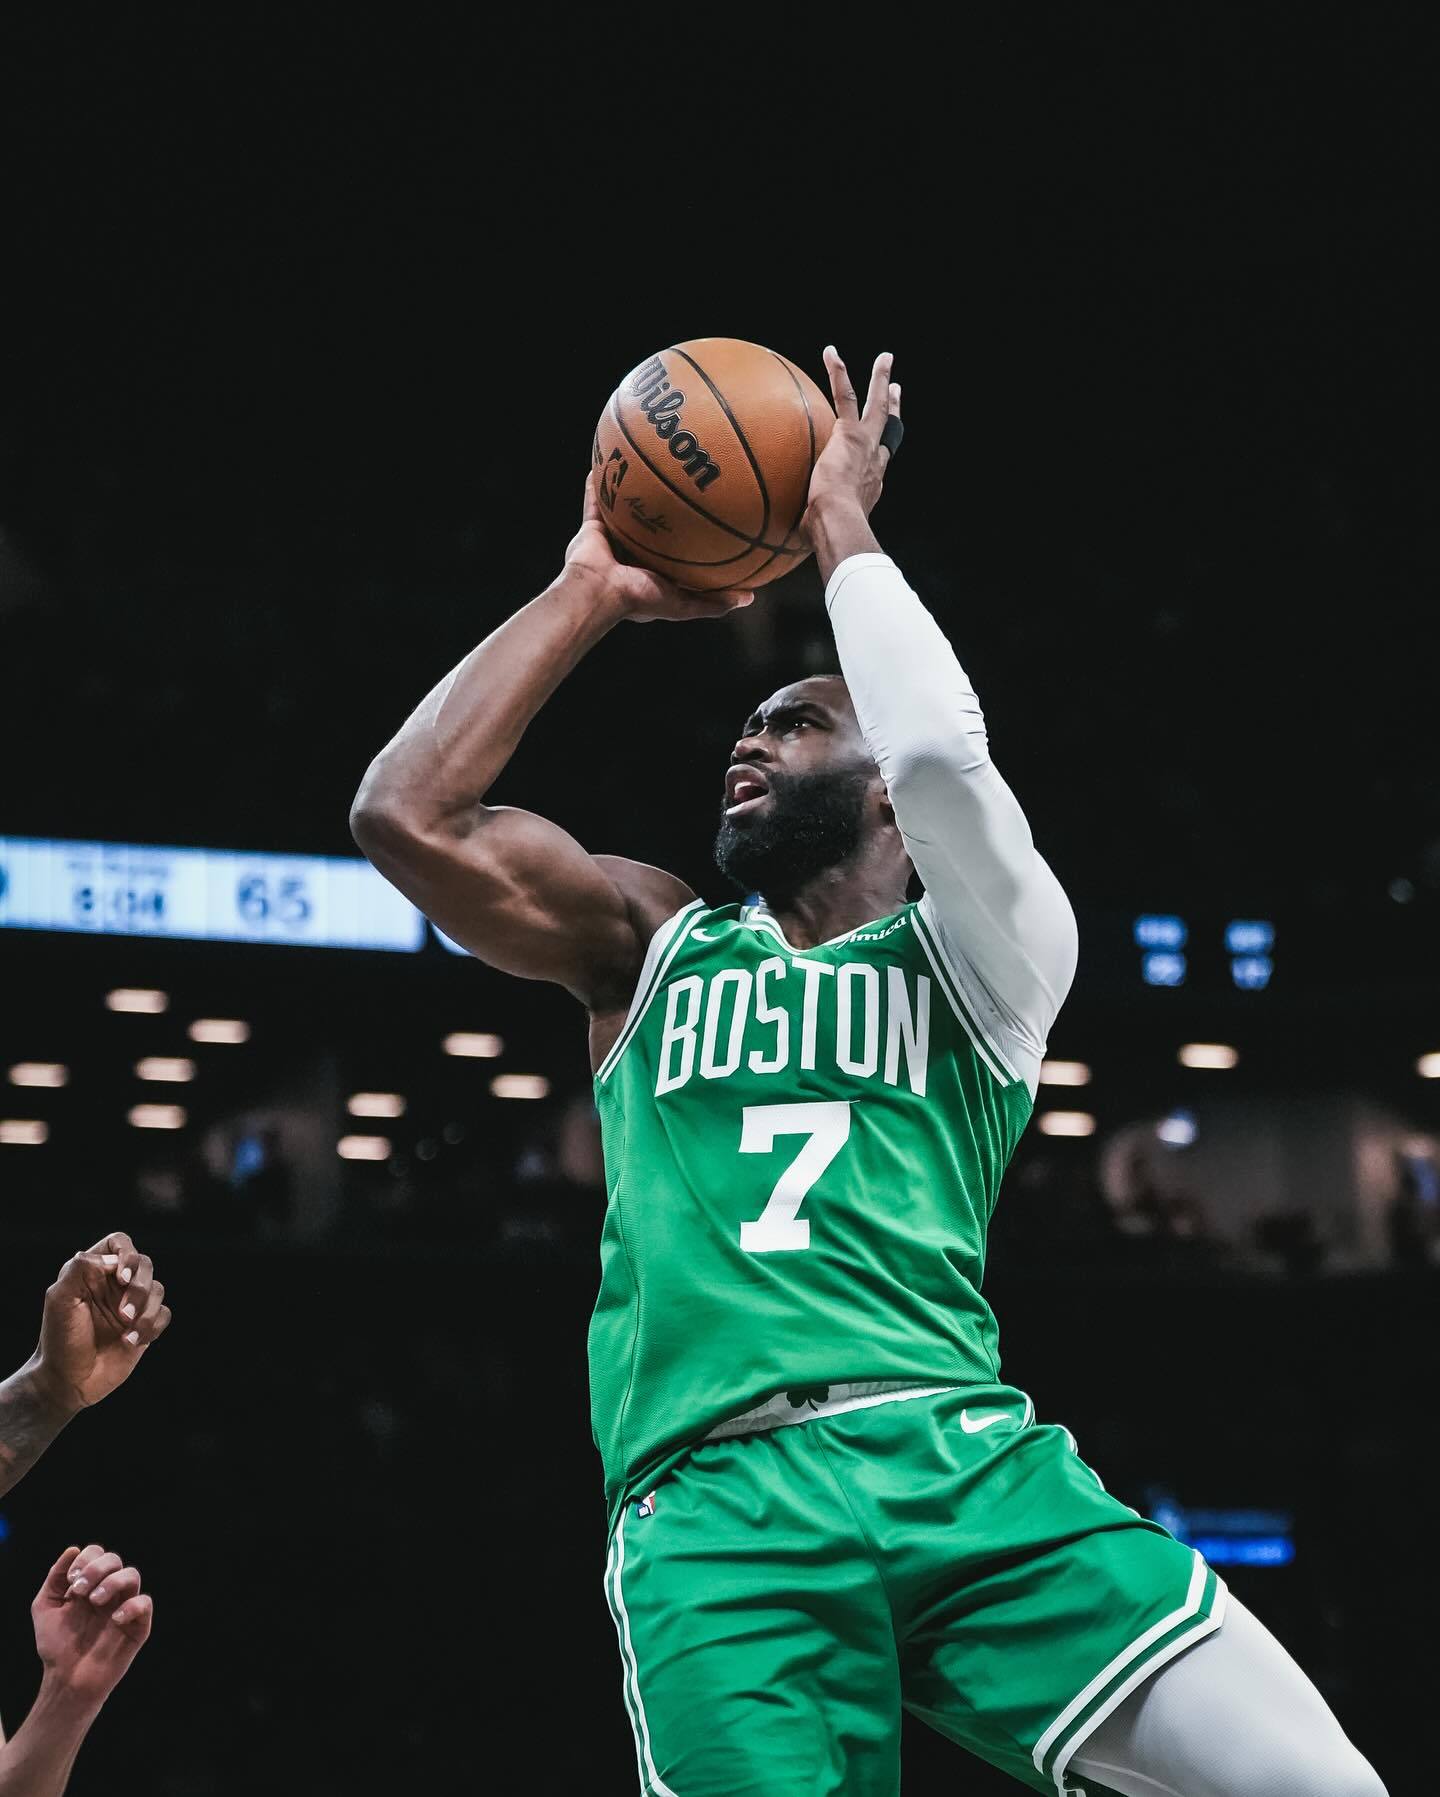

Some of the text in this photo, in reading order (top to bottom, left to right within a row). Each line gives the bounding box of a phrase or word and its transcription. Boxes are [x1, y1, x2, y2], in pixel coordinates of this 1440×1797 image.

[630, 354, 721, 493] Wilson
[235, 872, 314, 924] 65
[654, 956, 931, 1098] BOSTON
[738, 1101, 851, 1252] 7
